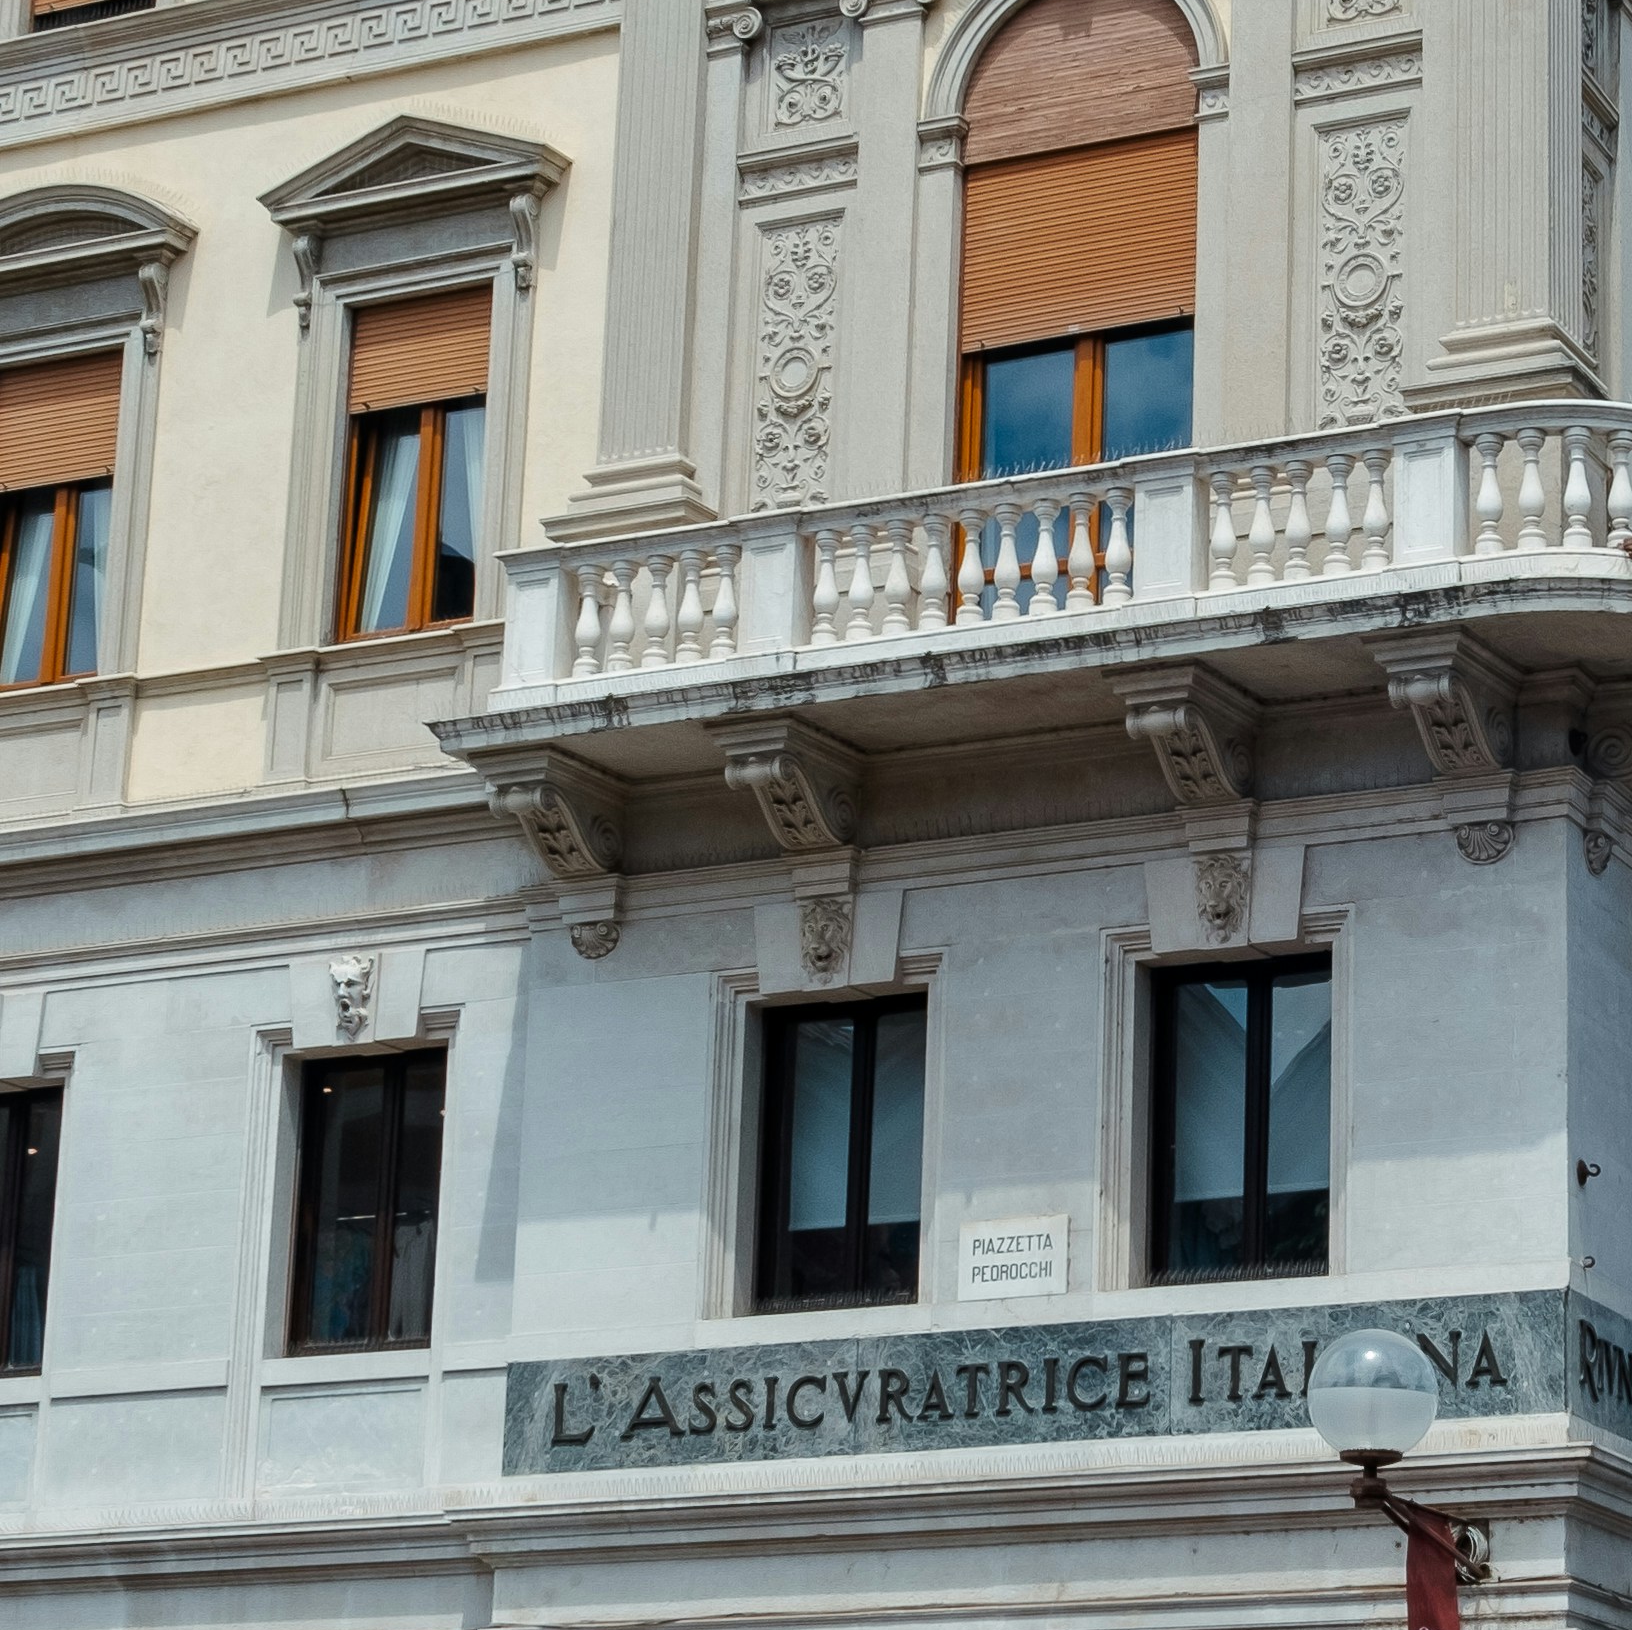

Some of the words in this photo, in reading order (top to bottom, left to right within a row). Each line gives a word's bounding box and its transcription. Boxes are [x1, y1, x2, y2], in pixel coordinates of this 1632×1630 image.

[972, 1233, 1053, 1256] PIAZZETTA
[971, 1260, 1053, 1283] PEDROCCHI
[1188, 1329, 1508, 1404] ITANA
